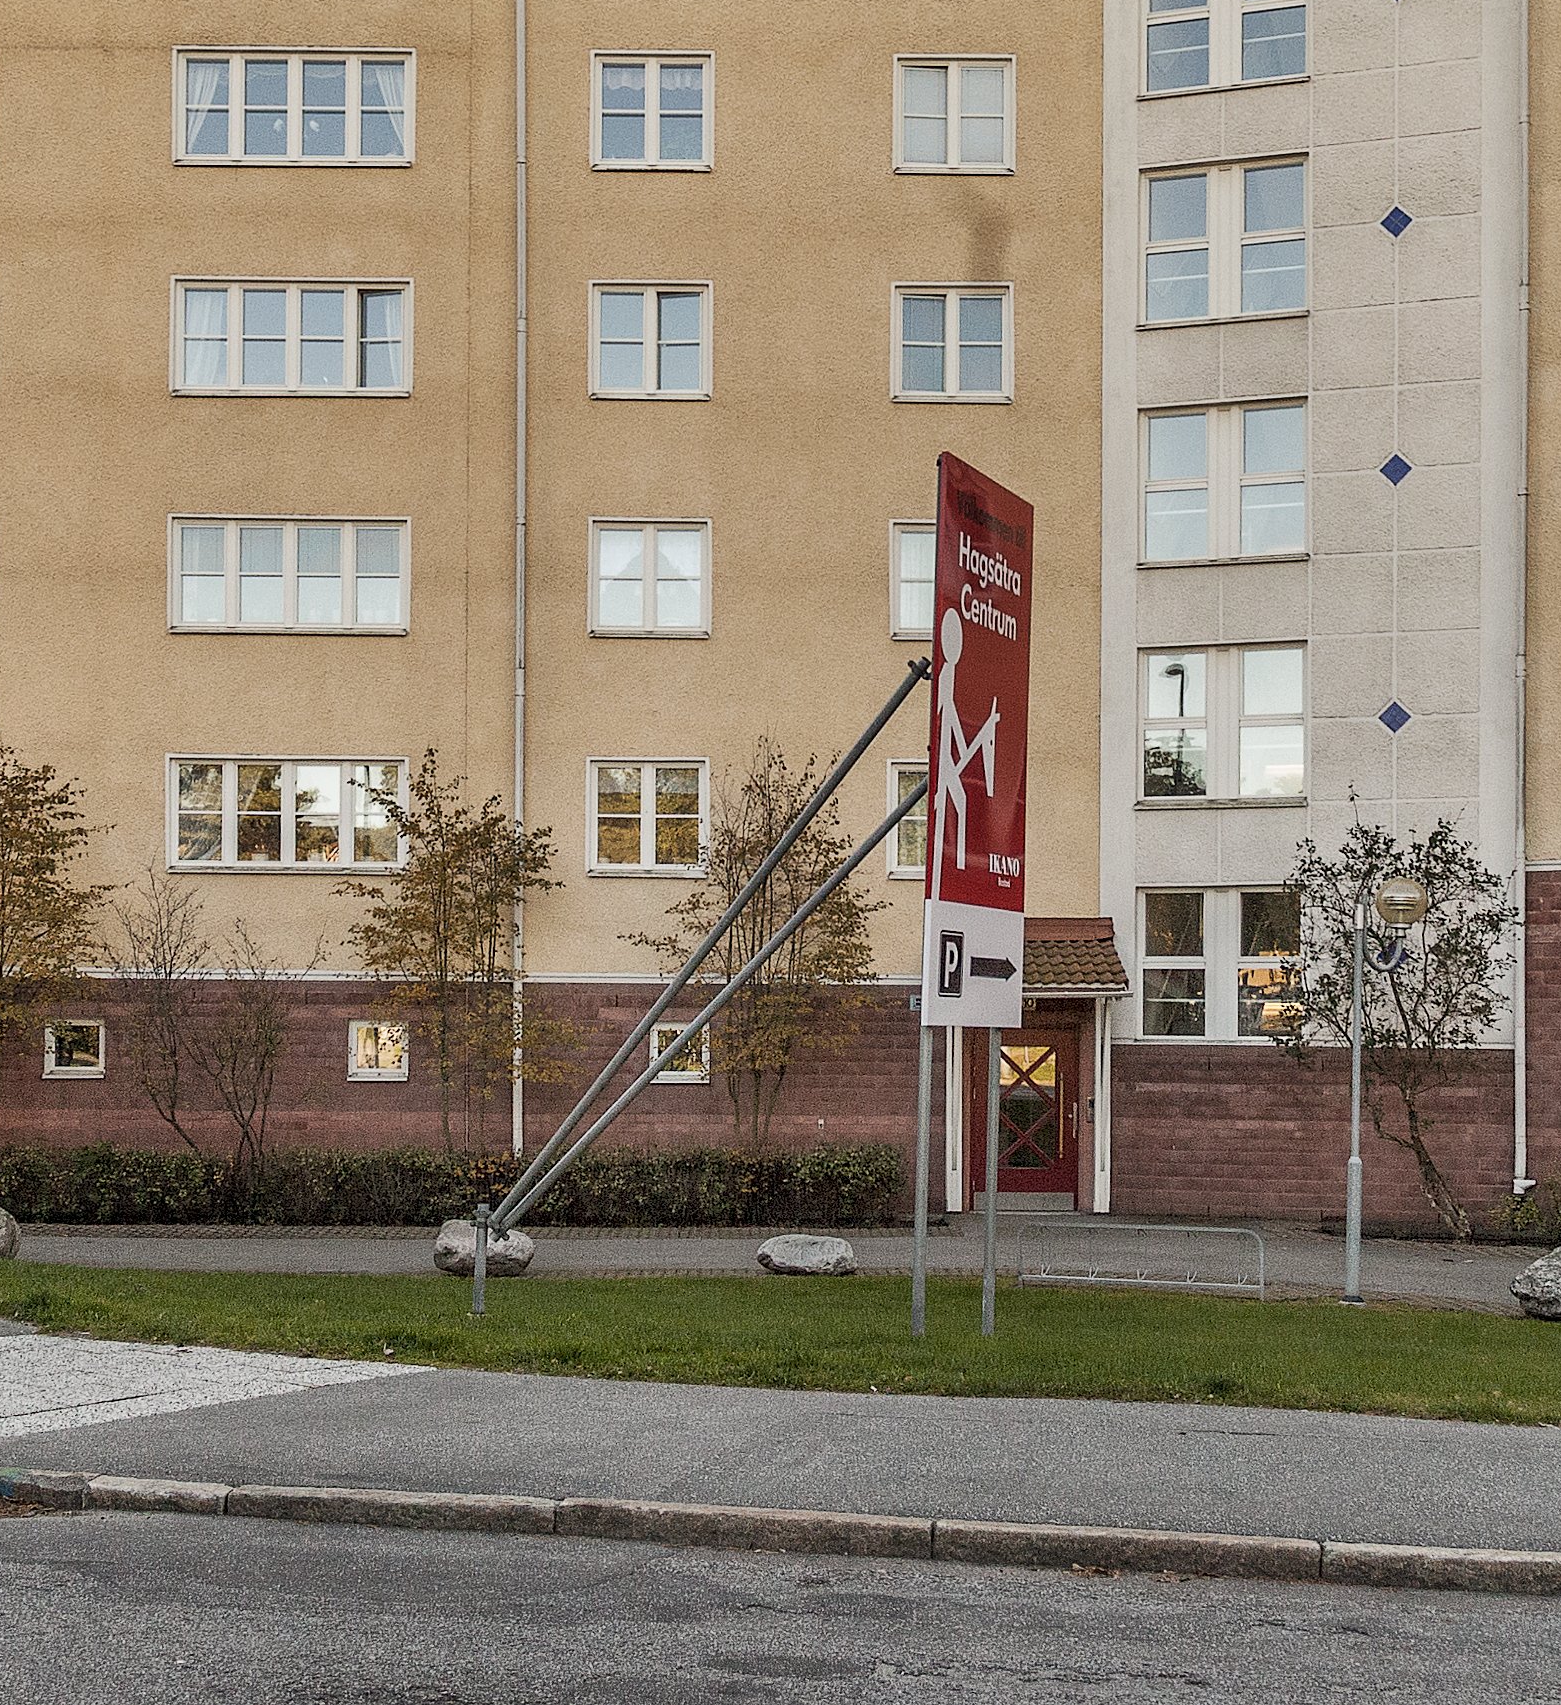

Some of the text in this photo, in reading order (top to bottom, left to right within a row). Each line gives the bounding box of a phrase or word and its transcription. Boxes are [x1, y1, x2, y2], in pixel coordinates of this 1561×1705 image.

[958, 531, 1021, 596] Hagsätra
[960, 583, 1017, 641] Centrum
[989, 853, 1020, 877] IKANO
[944, 941, 959, 988] P
